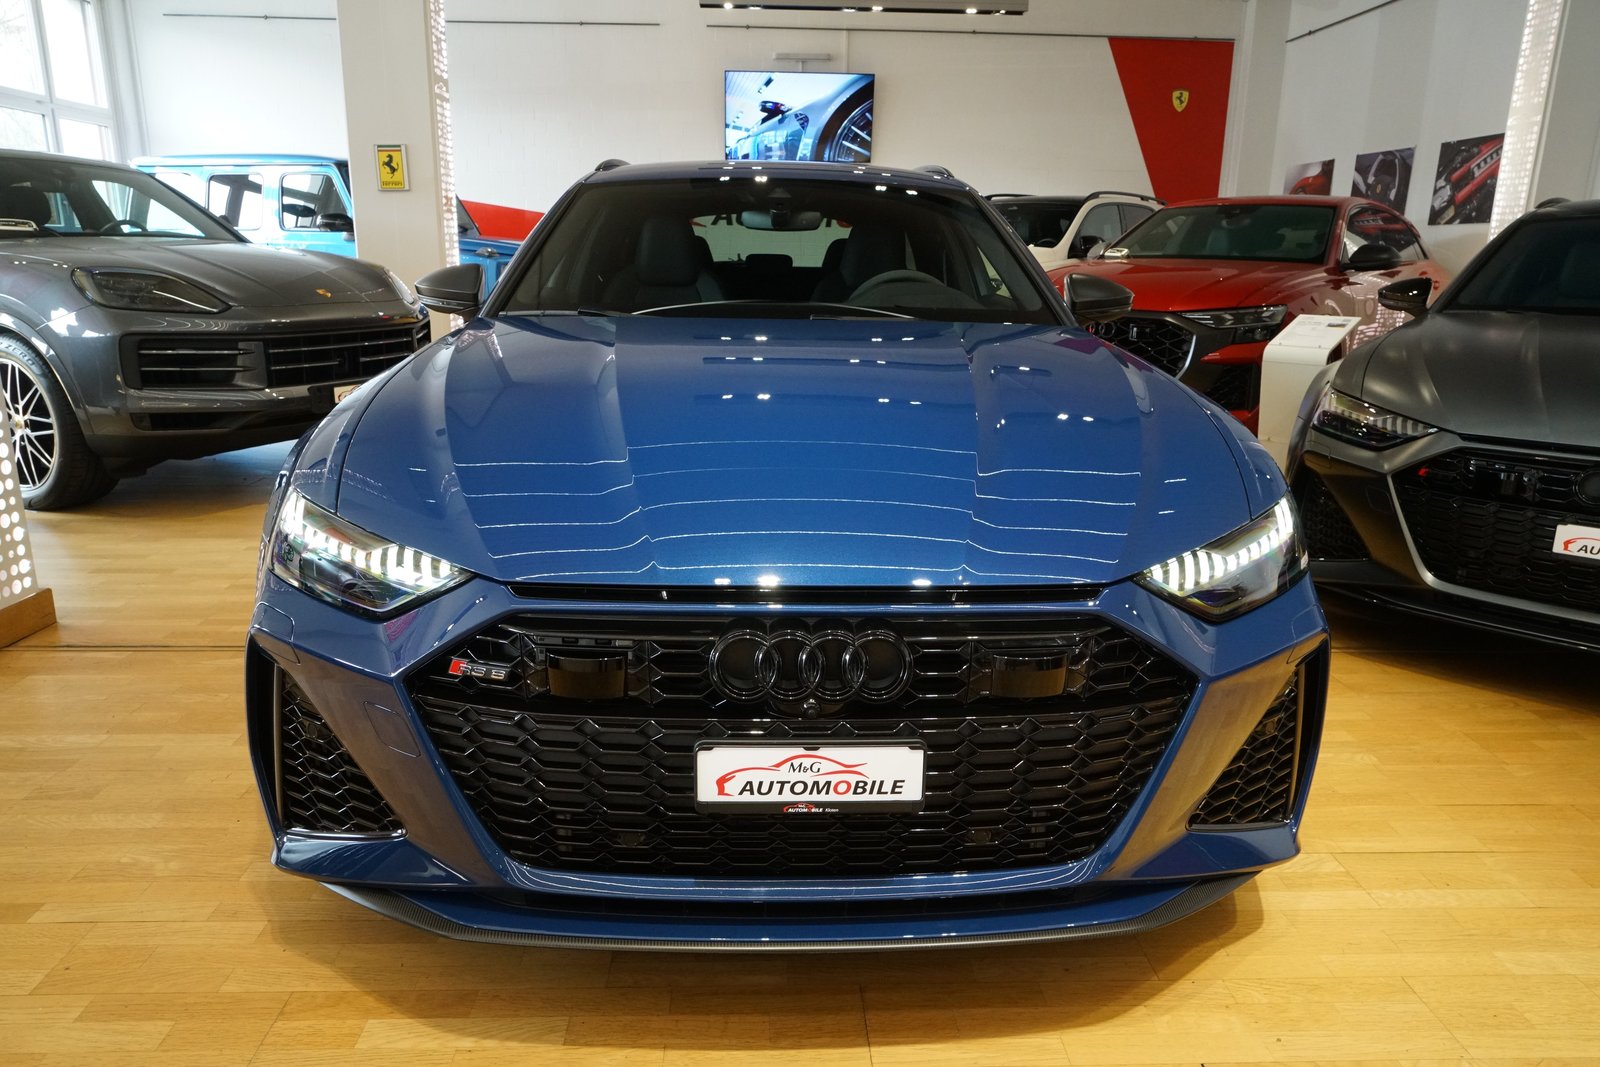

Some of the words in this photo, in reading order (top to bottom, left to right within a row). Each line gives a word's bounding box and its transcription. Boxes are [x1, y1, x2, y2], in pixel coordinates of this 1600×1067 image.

[4, 344, 35, 366] ZERO
[454, 661, 486, 677] RS
[788, 761, 822, 774] M&G
[737, 779, 905, 796] AUTOMOBILE
